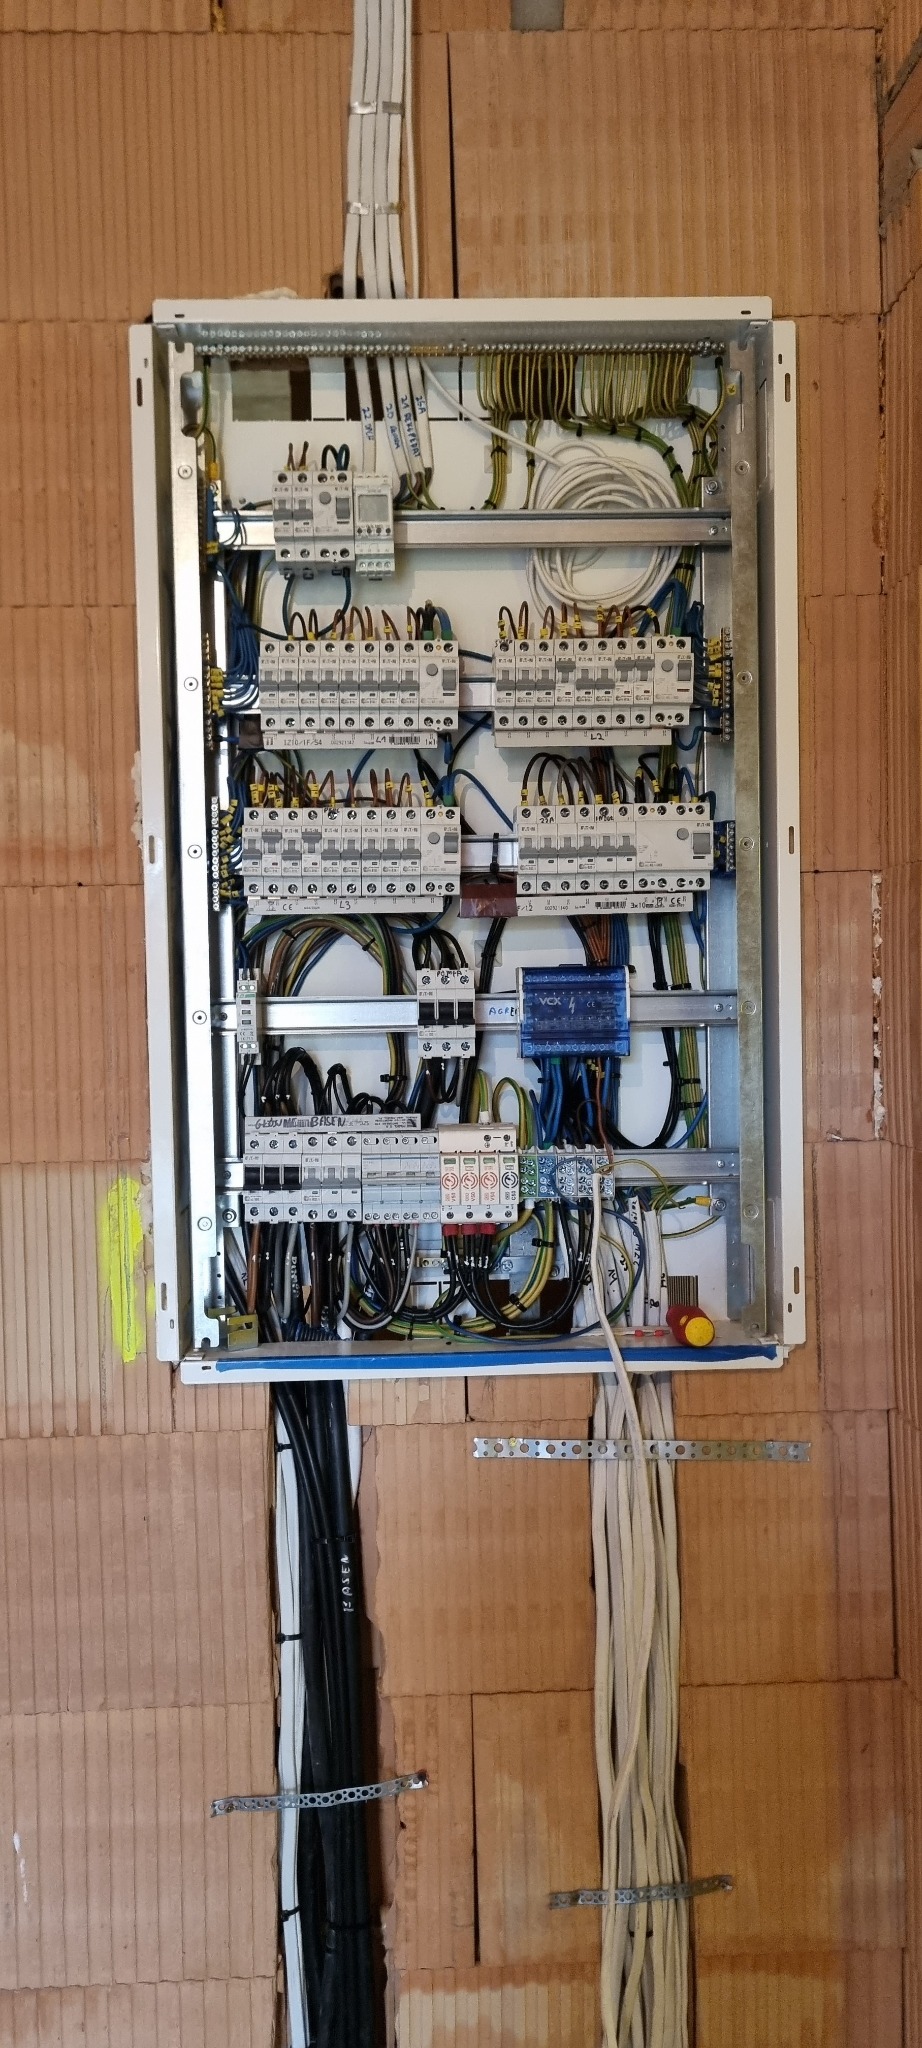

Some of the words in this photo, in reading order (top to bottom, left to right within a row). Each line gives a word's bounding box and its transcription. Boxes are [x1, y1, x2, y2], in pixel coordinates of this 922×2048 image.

[590, 733, 604, 741] L2
[282, 903, 293, 911] CE
[339, 900, 351, 910] L3
[539, 997, 562, 1006] VCX
[310, 1116, 346, 1128] BASEN
